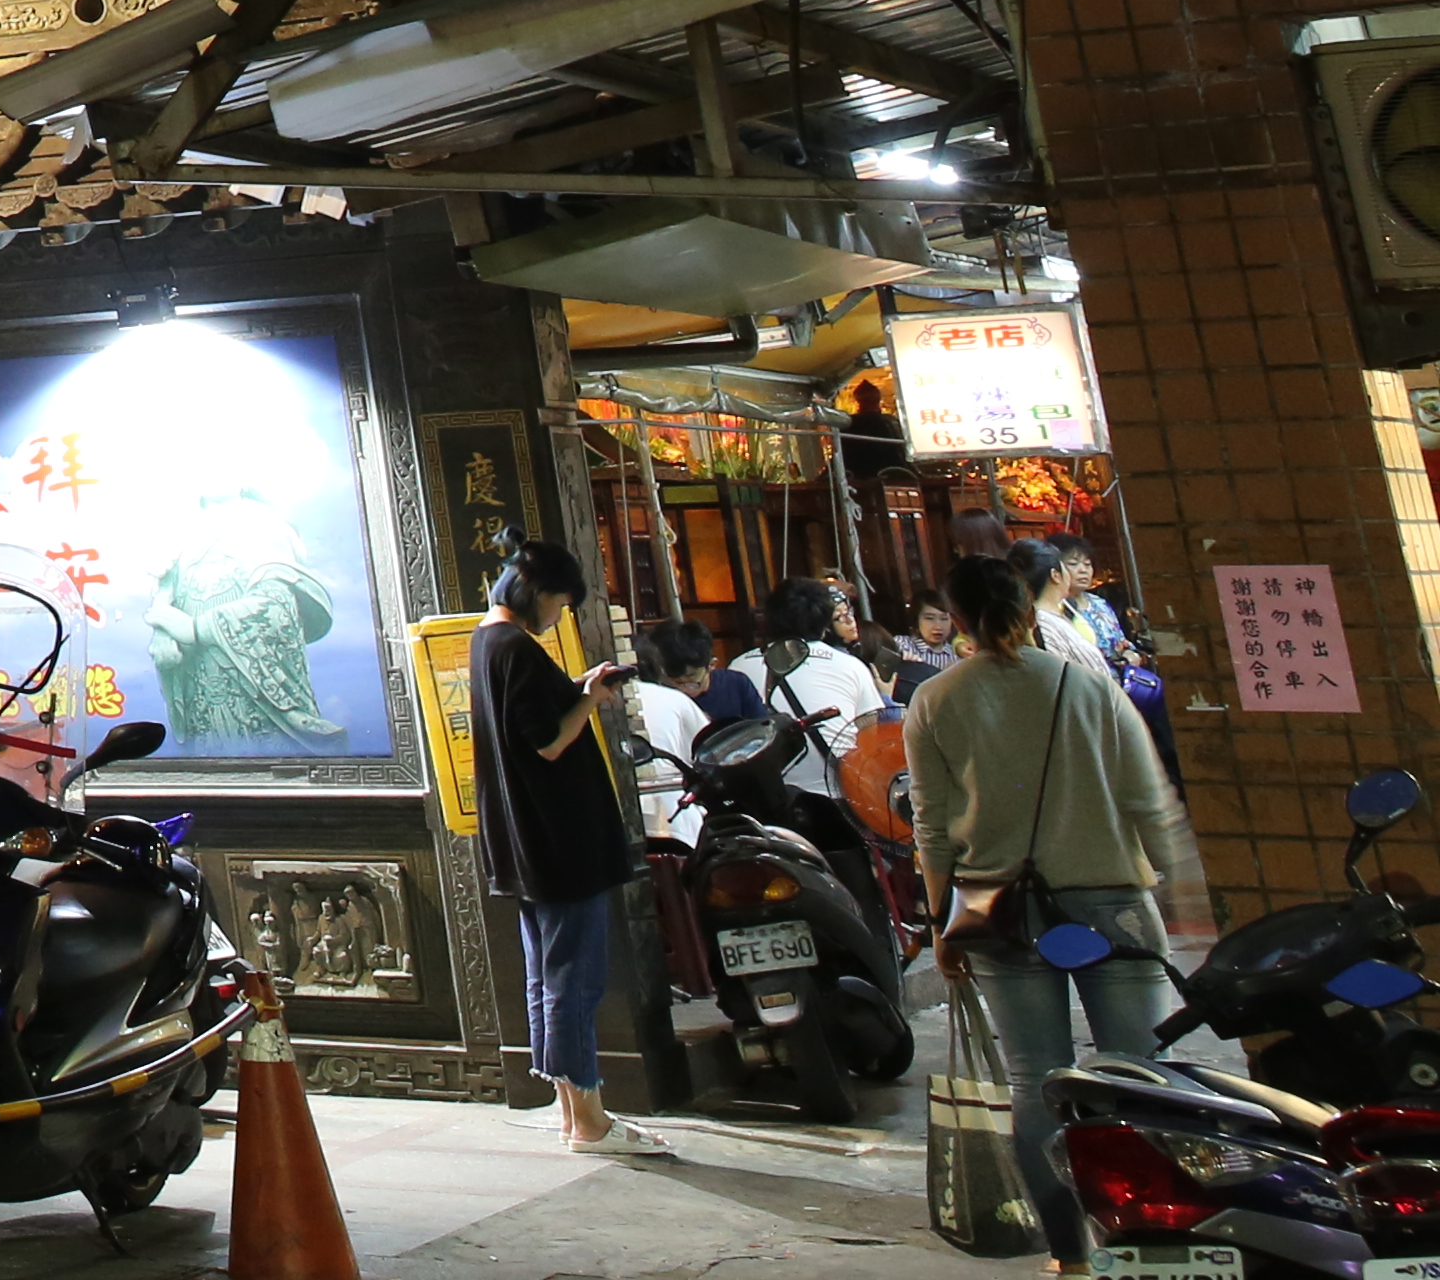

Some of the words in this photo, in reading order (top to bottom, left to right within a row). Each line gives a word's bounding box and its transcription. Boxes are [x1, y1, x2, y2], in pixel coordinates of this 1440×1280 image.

[938, 324, 1025, 351] 老店
[979, 427, 1019, 445] 35
[1230, 577, 1274, 700] 謝謝您的合作
[1263, 577, 1305, 689] 請勿停車
